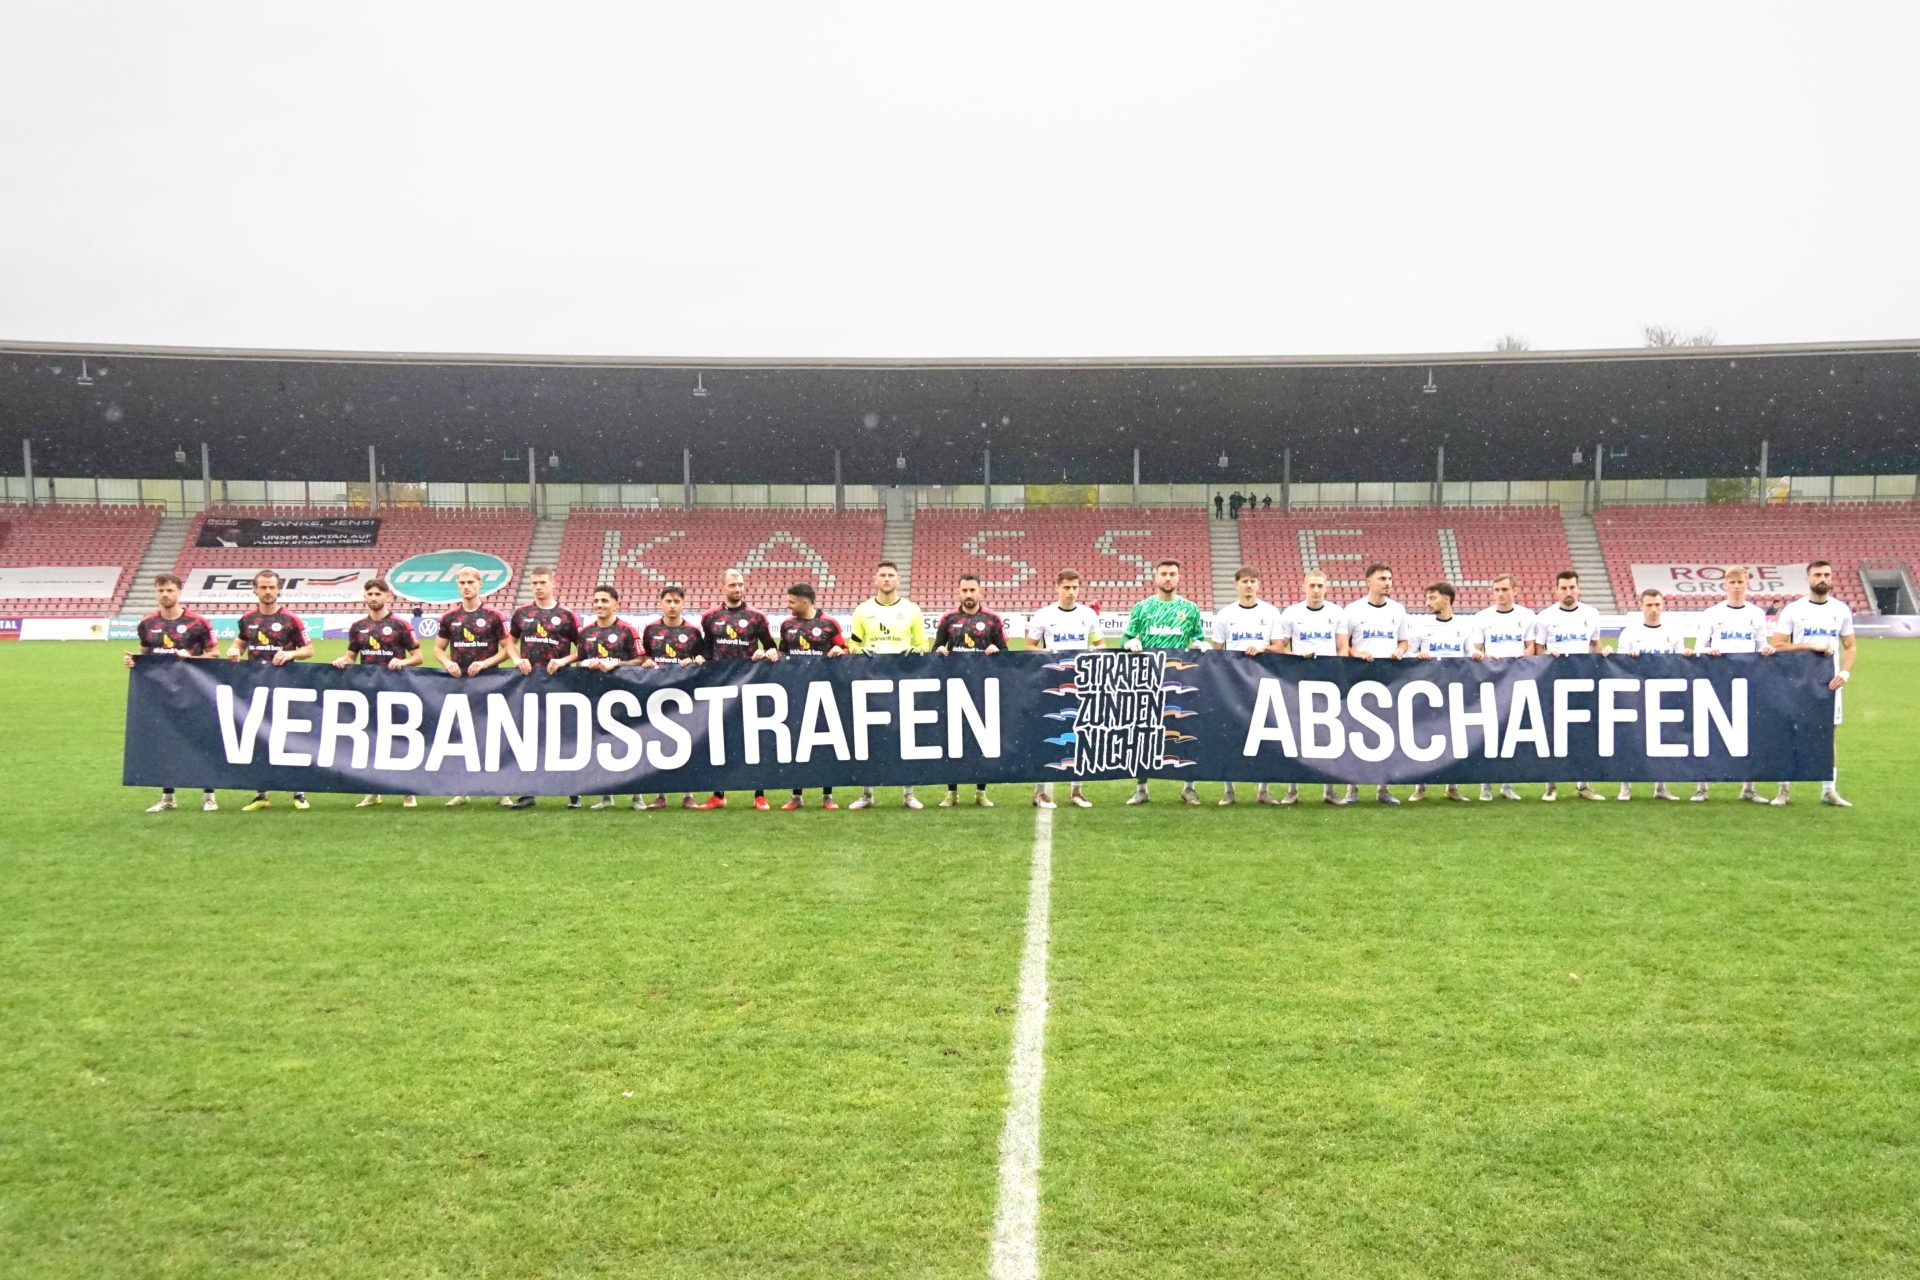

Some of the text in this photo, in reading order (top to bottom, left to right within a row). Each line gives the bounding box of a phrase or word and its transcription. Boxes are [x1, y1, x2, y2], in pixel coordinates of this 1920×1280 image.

[1074, 651, 1166, 692] STRAFEN
[216, 677, 1001, 773] VERBANDSSTRAFEN
[1074, 727, 1166, 777] NICHT!
[1243, 677, 1749, 762] ABSCHAFFEN
